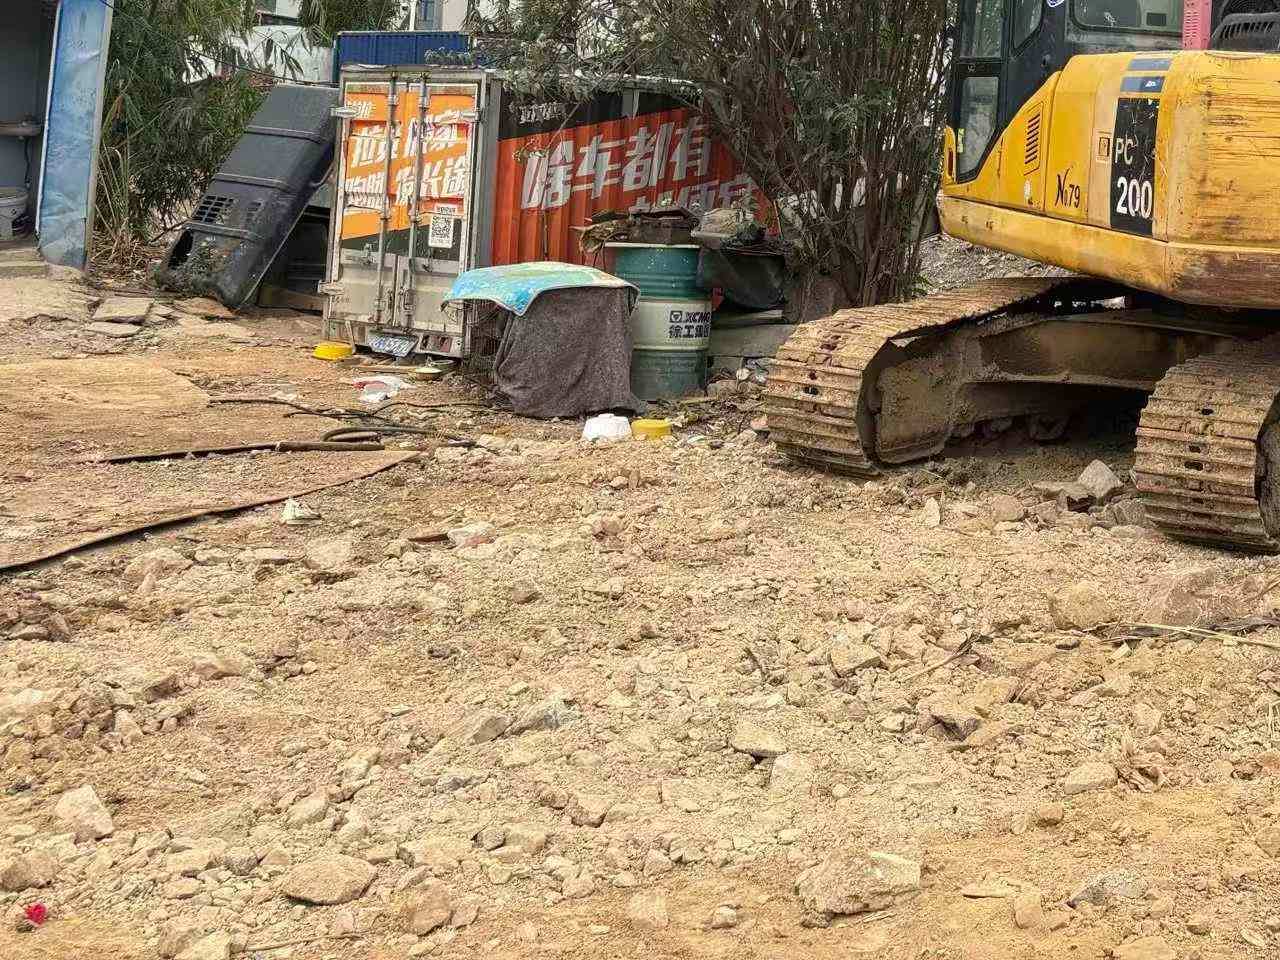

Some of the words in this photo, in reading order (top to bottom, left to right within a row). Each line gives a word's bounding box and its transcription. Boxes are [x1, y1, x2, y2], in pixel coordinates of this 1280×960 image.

[521, 117, 711, 210] 啥车都有
[1115, 137, 1134, 165] PC
[1116, 176, 1153, 219] 200
